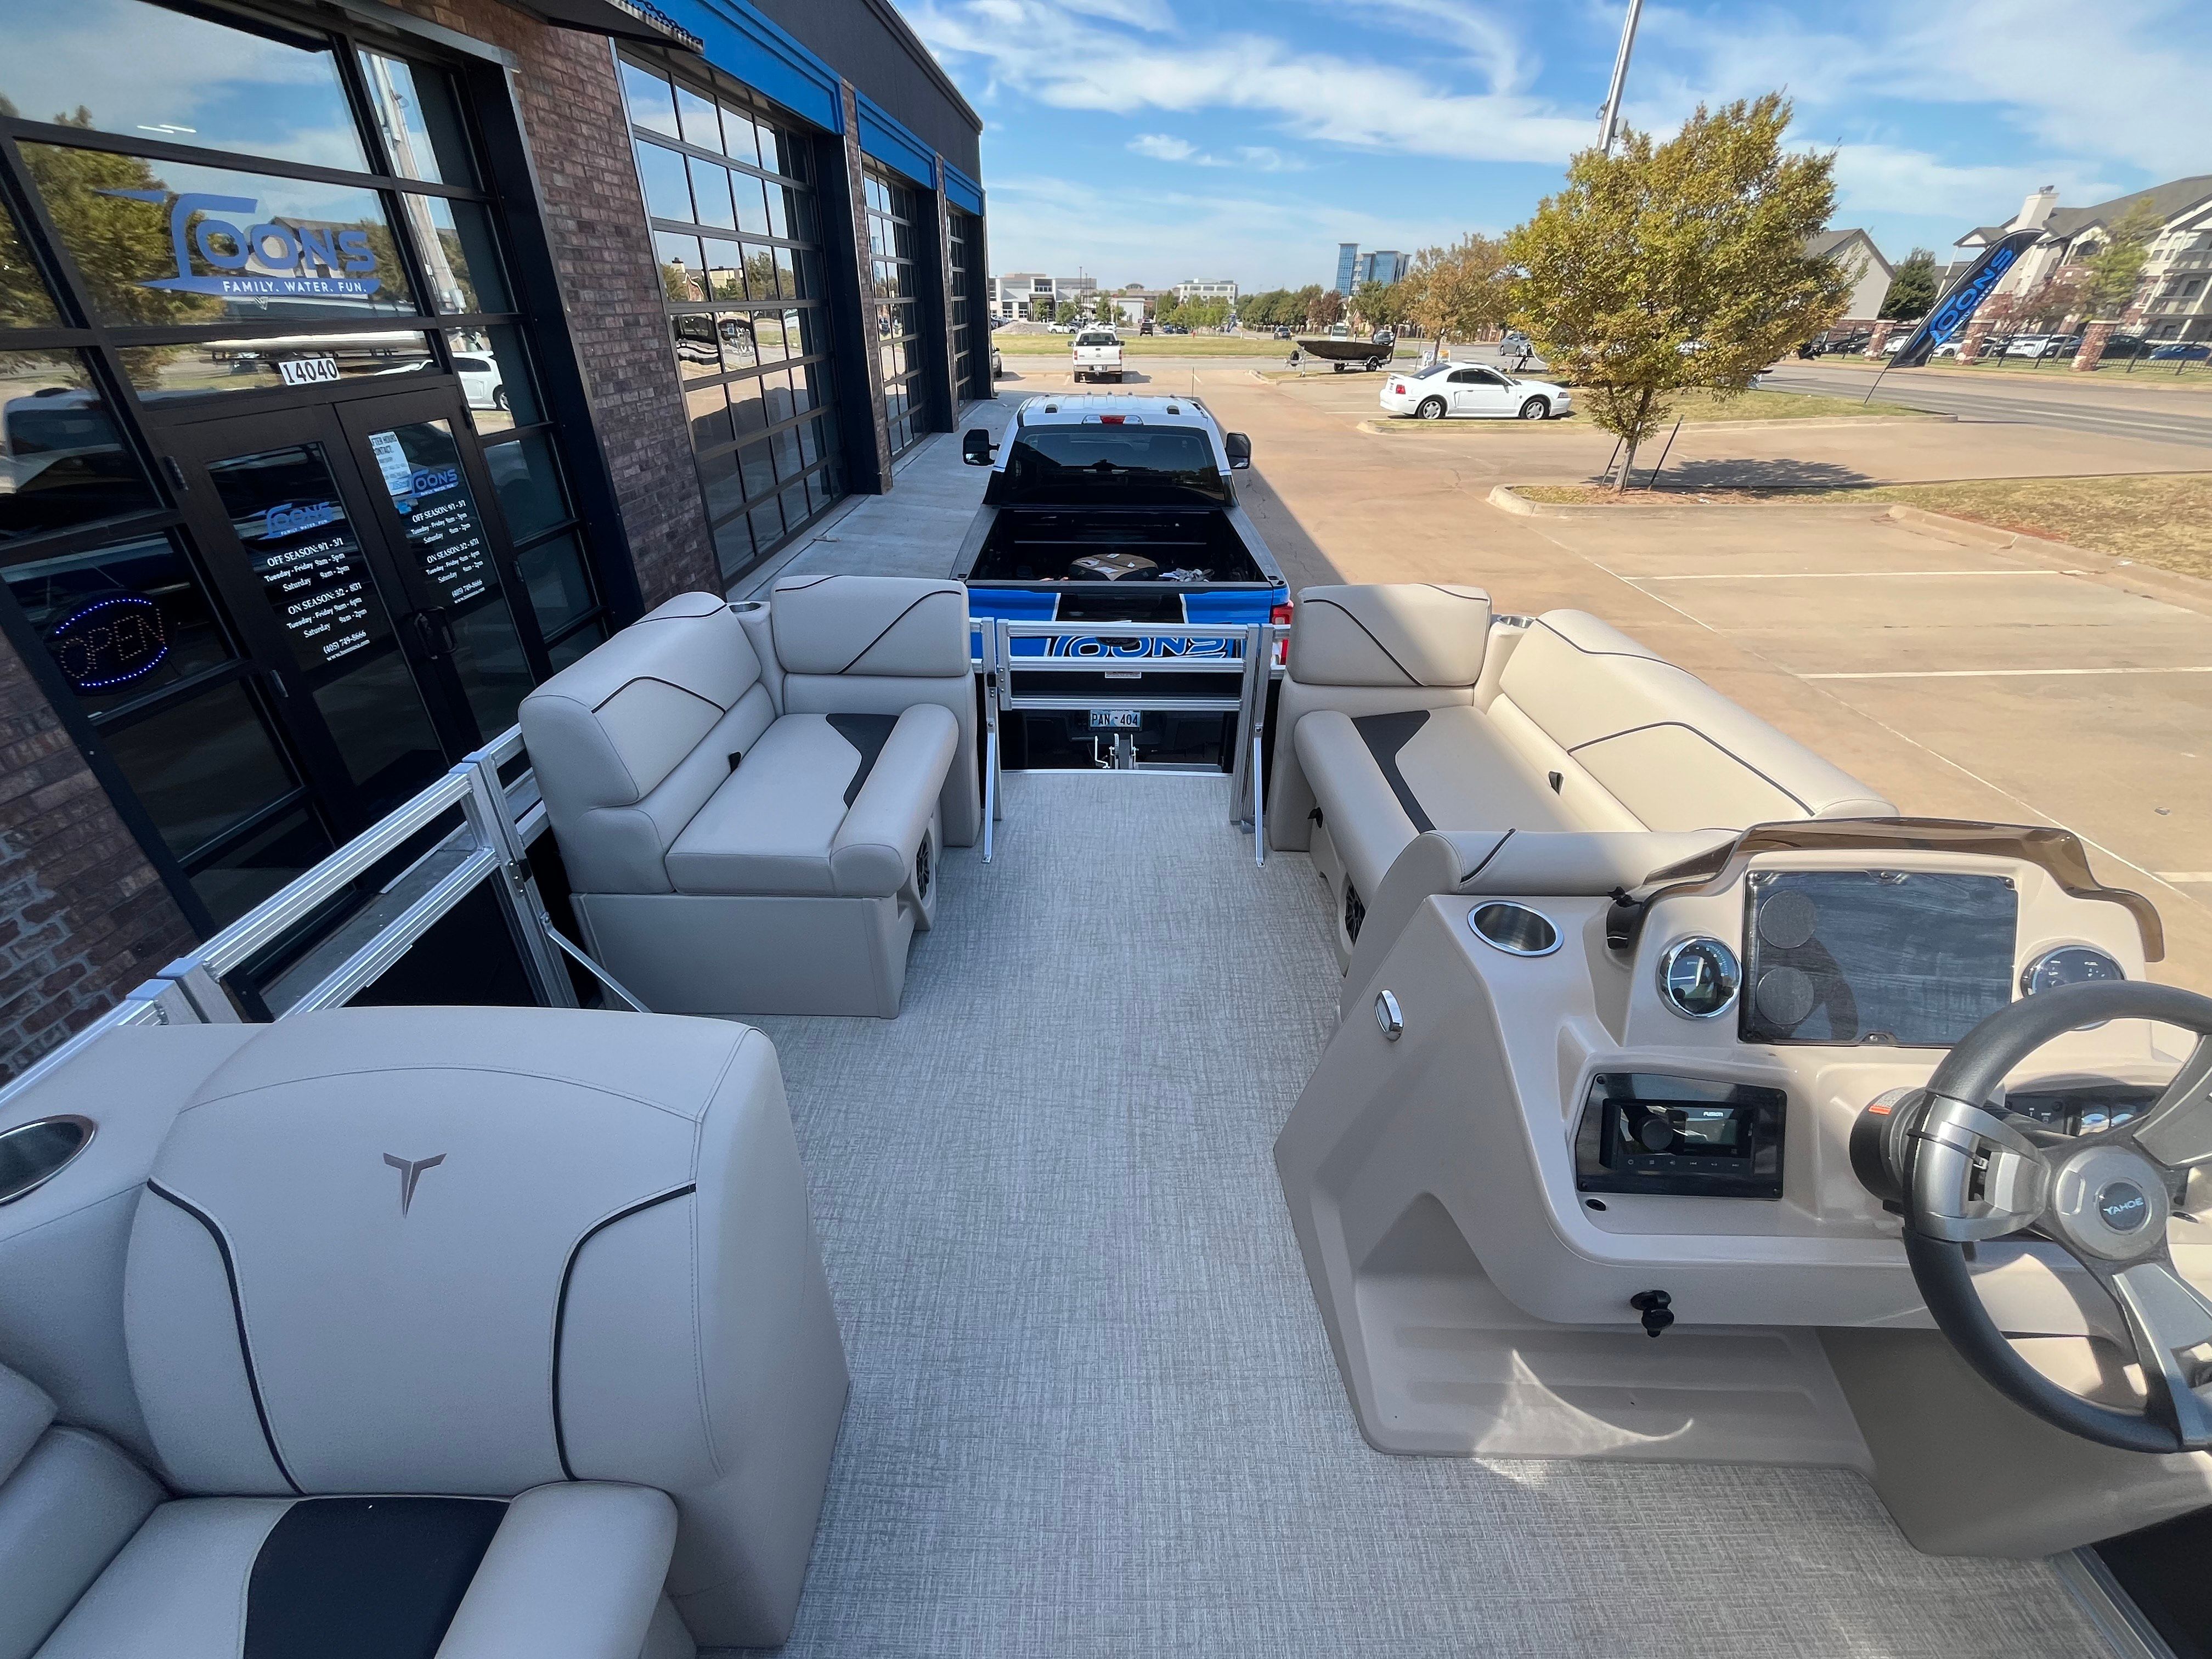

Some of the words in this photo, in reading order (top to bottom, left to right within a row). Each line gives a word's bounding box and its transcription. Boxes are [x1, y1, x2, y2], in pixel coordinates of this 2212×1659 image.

[97, 190, 375, 276] TOONS
[223, 280, 279, 293] FAMILY.
[284, 280, 333, 293] WATER.
[338, 281, 366, 293] FUN.
[1910, 247, 2013, 351] TOONS
[283, 360, 338, 383] 14040
[399, 469, 458, 494] TOONS
[413, 514, 424, 523] OFF
[267, 555, 283, 567] OFF
[284, 545, 319, 562] SEASON:
[318, 542, 329, 551] 9/1
[332, 538, 344, 548] 3/1
[427, 554, 437, 563] ON
[264, 570, 291, 582] Tuesday
[294, 562, 313, 573] Friday
[331, 552, 346, 563] 5pm
[283, 578, 312, 592] Saturday
[336, 565, 350, 575] 2pm
[287, 603, 302, 615] ON
[302, 592, 336, 610] SEASON:
[286, 616, 313, 629] Tuesday
[315, 608, 334, 618] Friday
[303, 623, 331, 638] Saturday
[354, 609, 368, 618] 2pm
[59, 608, 165, 678] OPEN
[323, 641, 340, 654] (405)
[2103, 1197, 2143, 1215] TAHOE
